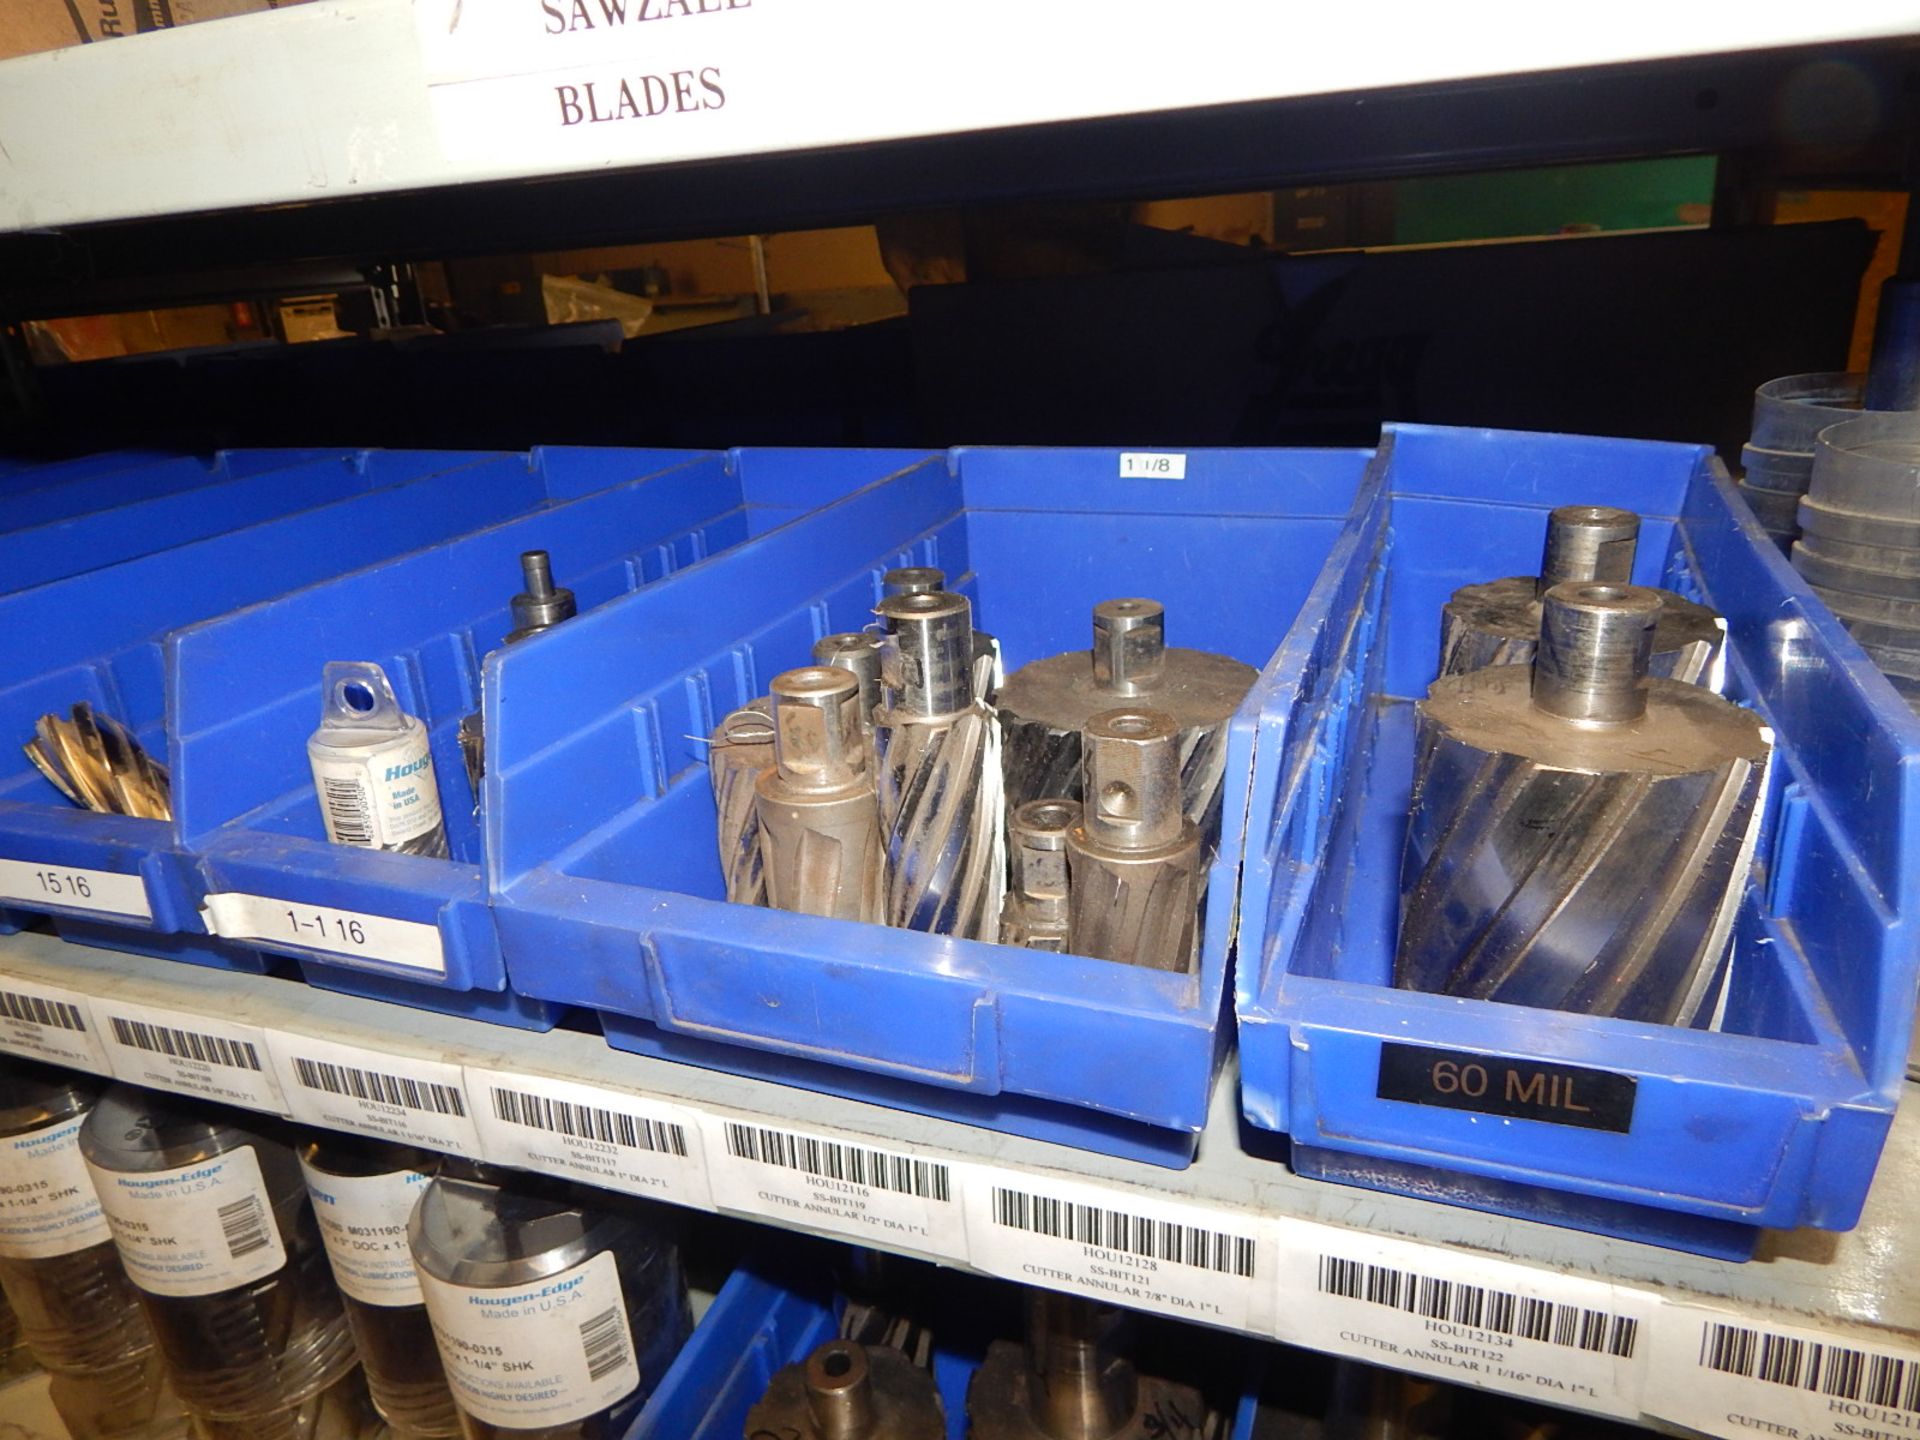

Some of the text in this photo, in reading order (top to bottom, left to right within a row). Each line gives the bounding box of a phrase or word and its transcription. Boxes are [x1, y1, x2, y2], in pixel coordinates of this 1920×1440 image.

[554, 66, 726, 126] BLADES
[1431, 1060, 1591, 1113] 60 MIL
[562, 1135, 619, 1155] HOU12232
[527, 1152, 567, 1166] CUTTER
[569, 1161, 616, 1177] ANNULAR
[629, 1174, 649, 1184] DIA
[570, 1151, 617, 1167] SS-BIT117
[118, 1165, 223, 1189] Hougen-Edge
[805, 1175, 870, 1197] HOU12116
[48, 1186, 79, 1201] SHK
[813, 1192, 866, 1209] SS-BIT119
[757, 1190, 801, 1208] CUTTER
[803, 1202, 859, 1220] ANNULAR
[883, 1219, 905, 1231] DIA
[150, 1236, 178, 1246] SHK
[352, 1240, 380, 1252] DOC
[1083, 1246, 1158, 1272] HOU12128
[1089, 1264, 1150, 1286] SS-BIT121
[469, 1275, 585, 1307] Hougen-Edge
[1022, 1263, 1073, 1282] CUTTER
[1076, 1275, 1141, 1298] ANNULAR
[1170, 1296, 1195, 1310] DIA
[1214, 1306, 1224, 1315] L
[480, 1309, 520, 1320] Made
[523, 1306, 536, 1316] in
[1424, 1319, 1514, 1349] HOU12134
[1430, 1338, 1505, 1363] SS-BIT122
[503, 1360, 535, 1372] SHK
[1339, 1330, 1399, 1354] CUTTER
[1402, 1347, 1480, 1372] ANNULAR
[1535, 1375, 1570, 1392] DIA
[1588, 1387, 1599, 1398] L
[1726, 1412, 1799, 1439] CUTTER
